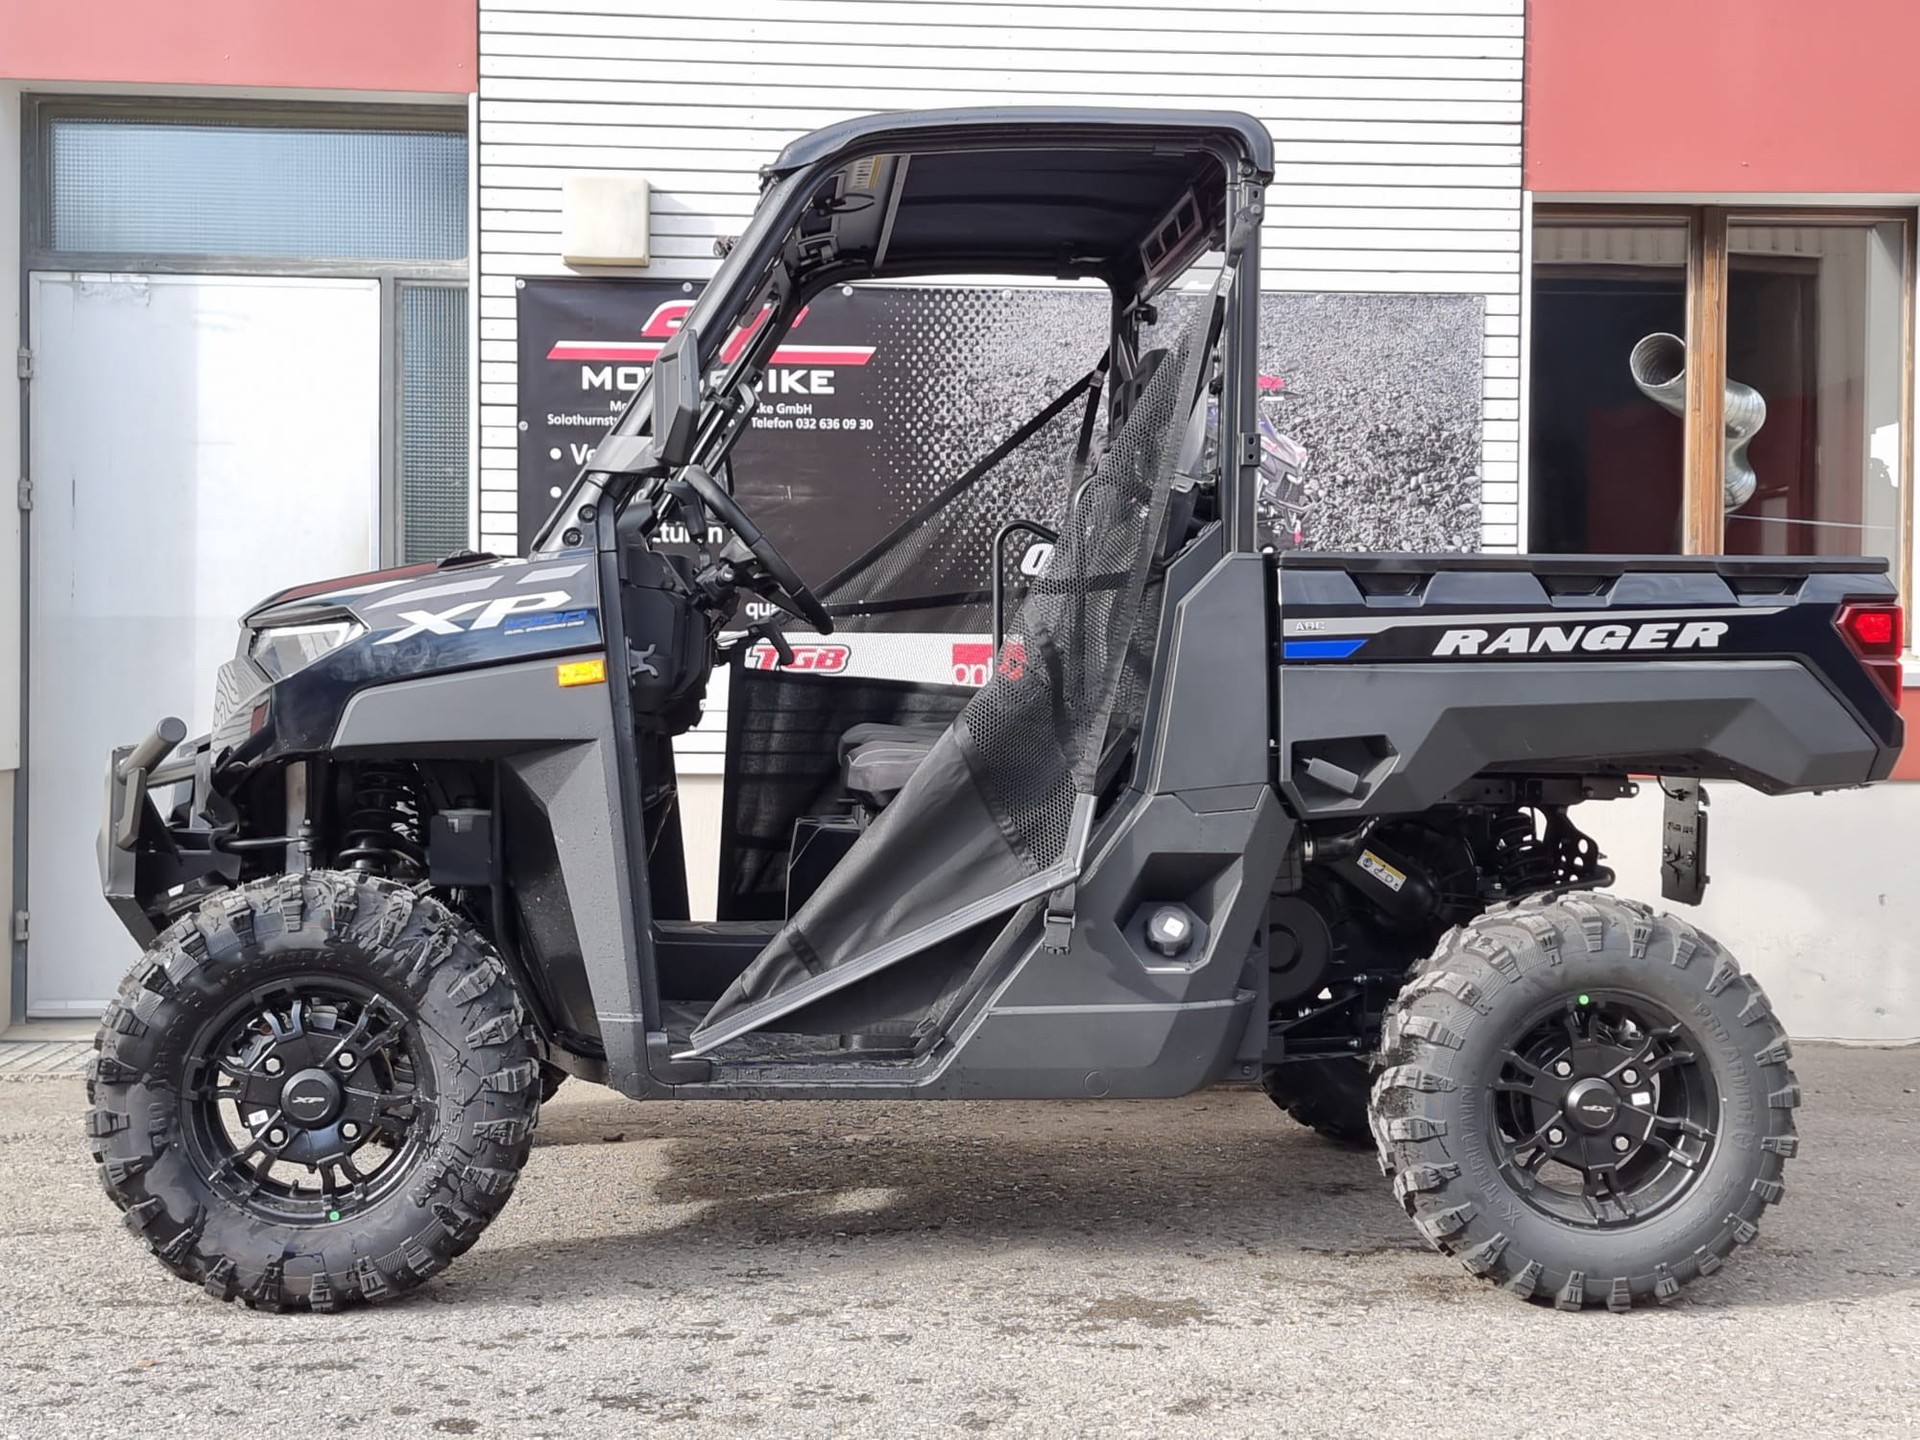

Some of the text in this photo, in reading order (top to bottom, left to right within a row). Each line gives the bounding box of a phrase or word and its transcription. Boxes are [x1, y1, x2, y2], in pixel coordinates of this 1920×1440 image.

[776, 403, 812, 415] GmbH
[751, 417, 873, 430] Telefon 032 636 09 30
[371, 590, 572, 646] XP
[1432, 621, 1728, 656] RANGER
